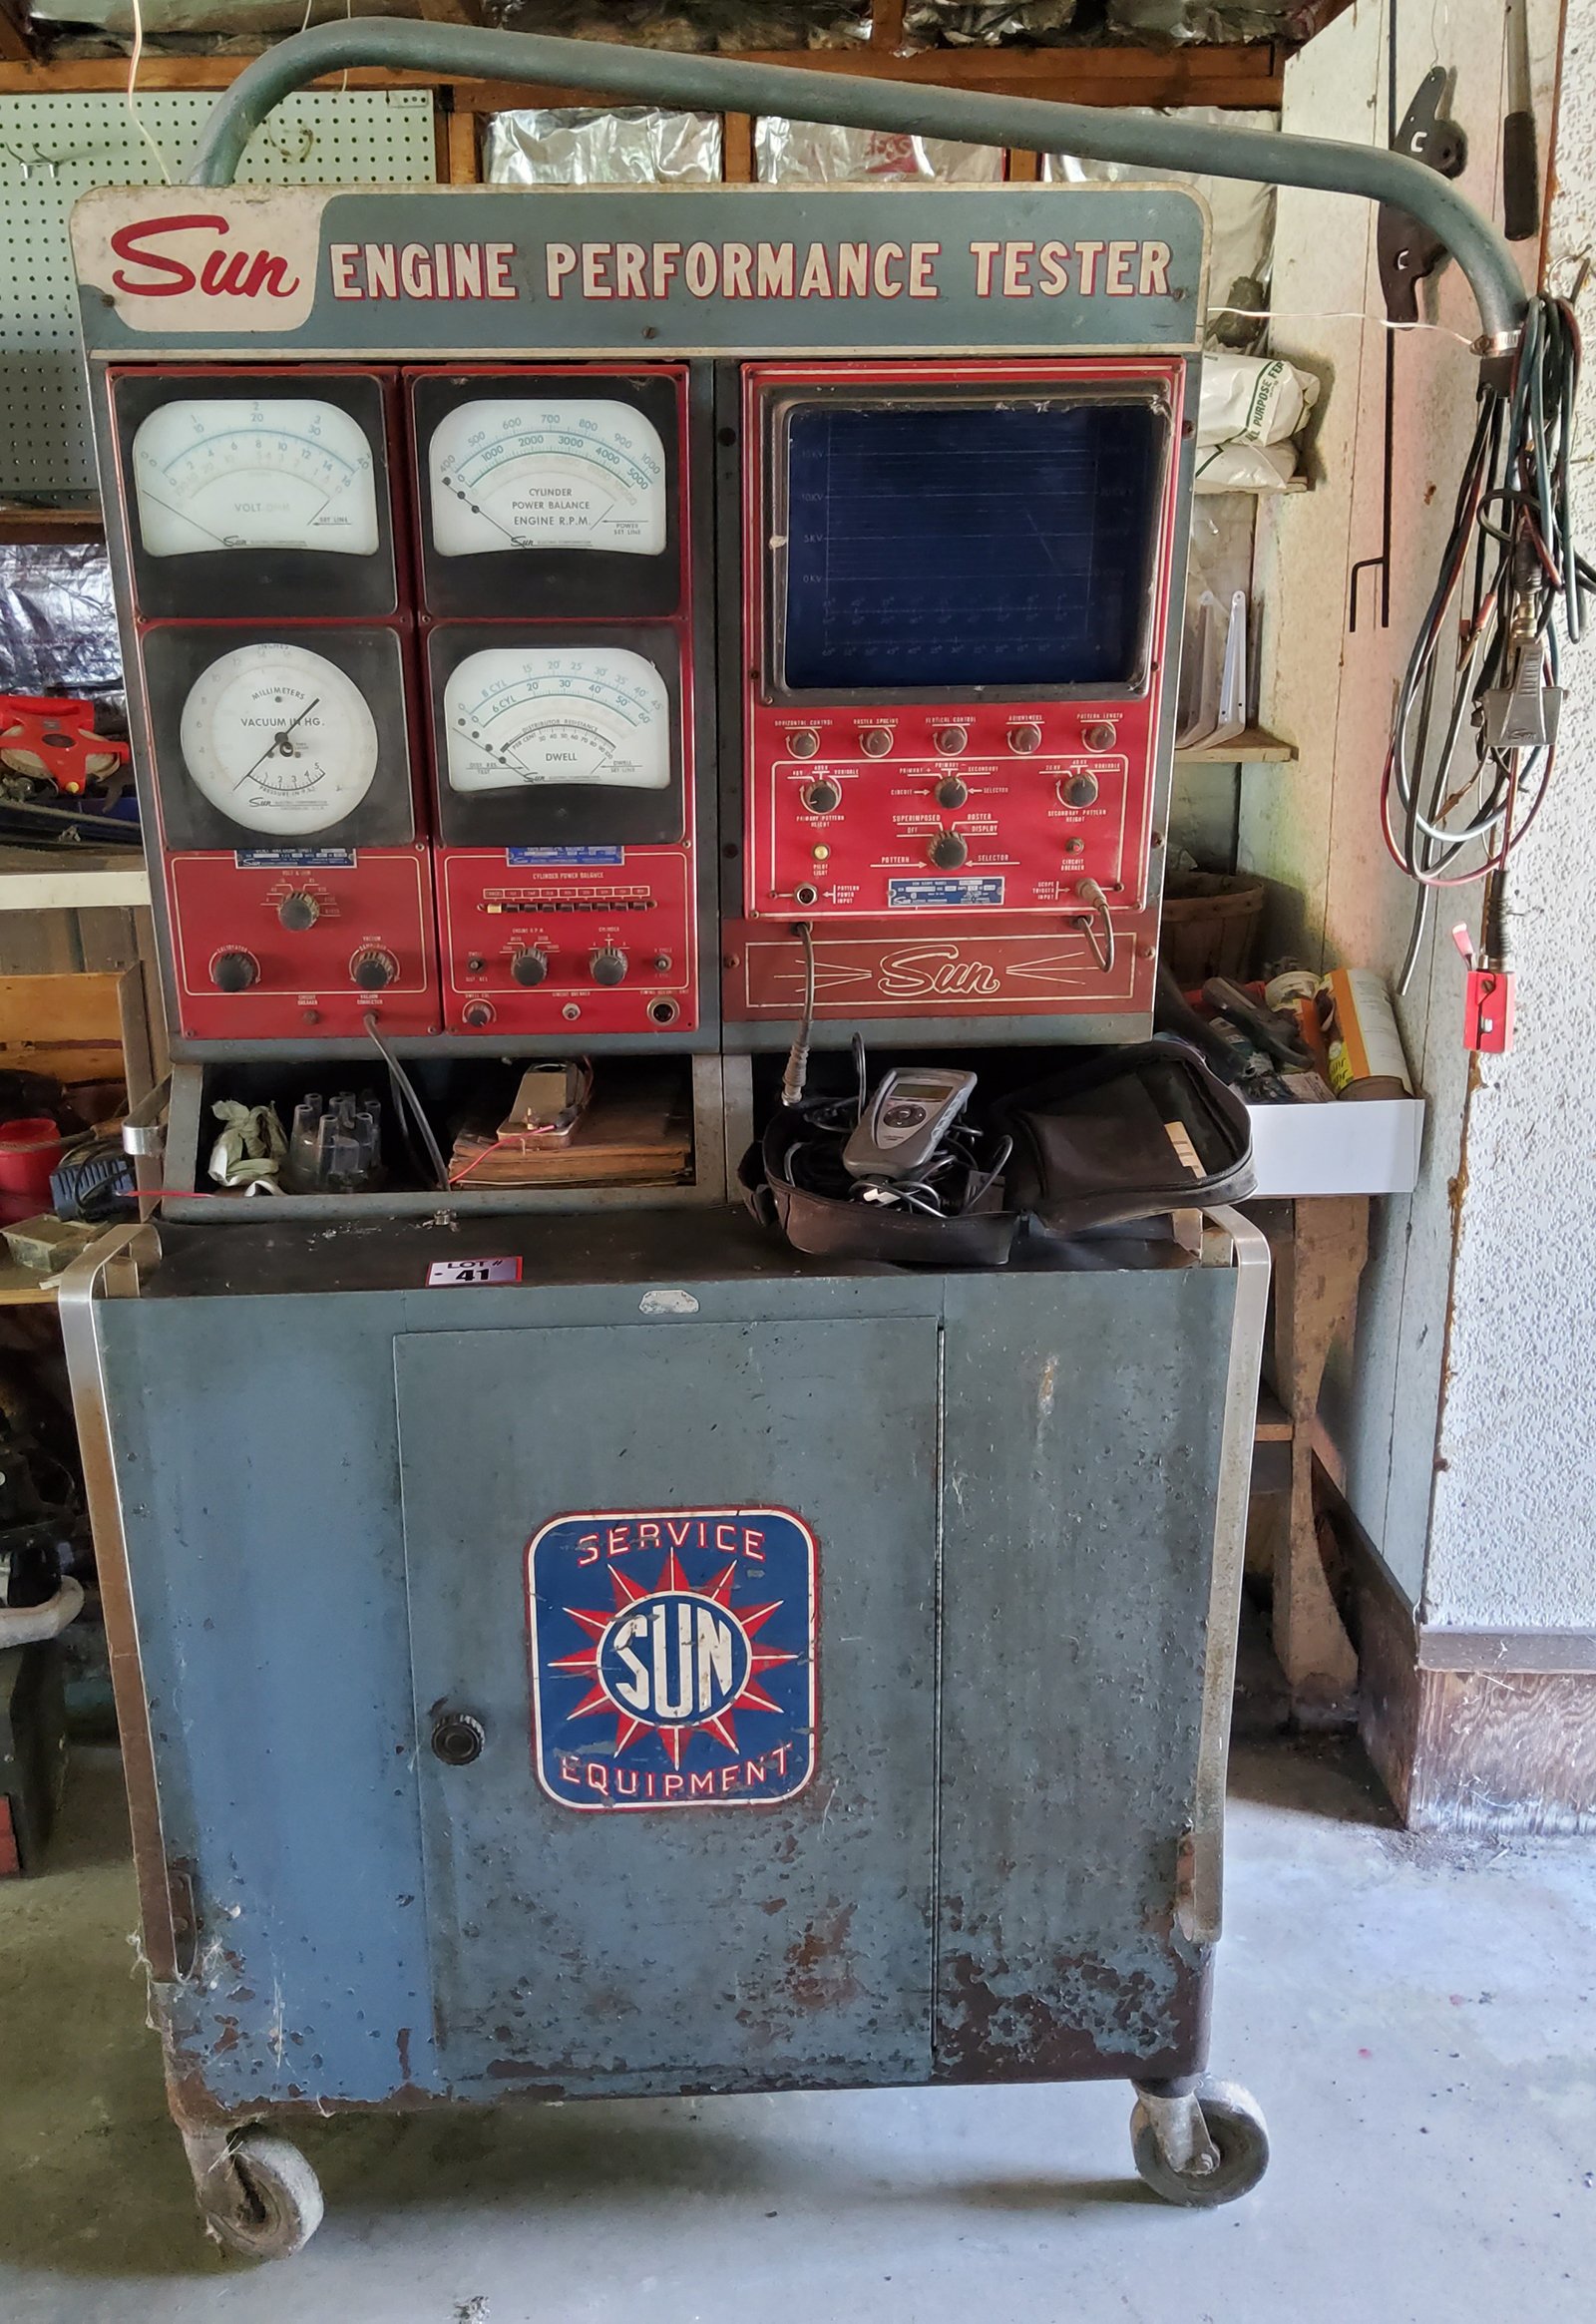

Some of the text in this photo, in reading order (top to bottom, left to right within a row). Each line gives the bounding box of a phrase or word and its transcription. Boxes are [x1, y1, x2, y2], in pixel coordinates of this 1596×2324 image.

[111, 214, 299, 297] Sun
[329, 239, 1174, 300] ENGINE PERFORMANCE TESTER
[1253, 379, 1272, 427] PURPOSE
[250, 413, 263, 423] 20
[307, 423, 321, 437] 30
[439, 414, 661, 475] 400 500 600 700 800 900 1000
[277, 442, 288, 452] 10
[301, 448, 312, 460] 12
[322, 460, 333, 472] 14
[457, 434, 648, 490] 0 1000 2000 3000 4000 5000
[529, 488, 573, 497] CYLINDER
[233, 503, 261, 512] VOLT
[514, 517, 555, 526] ENGINE
[251, 686, 305, 701] MILLIMETERS
[500, 695, 517, 709] CYL
[240, 718, 286, 727] VACUUM
[522, 718, 561, 733] DISTRIBUTOR
[545, 753, 579, 762] DWELL
[248, 797, 272, 807] Sun
[878, 945, 1000, 995] Sun
[447, 1260, 485, 1270] LOT
[455, 1268, 491, 1282] 41
[578, 1521, 765, 1568] SERVICE
[613, 1603, 733, 1719] SUN
[560, 1742, 794, 1797] EQUIPMENT
